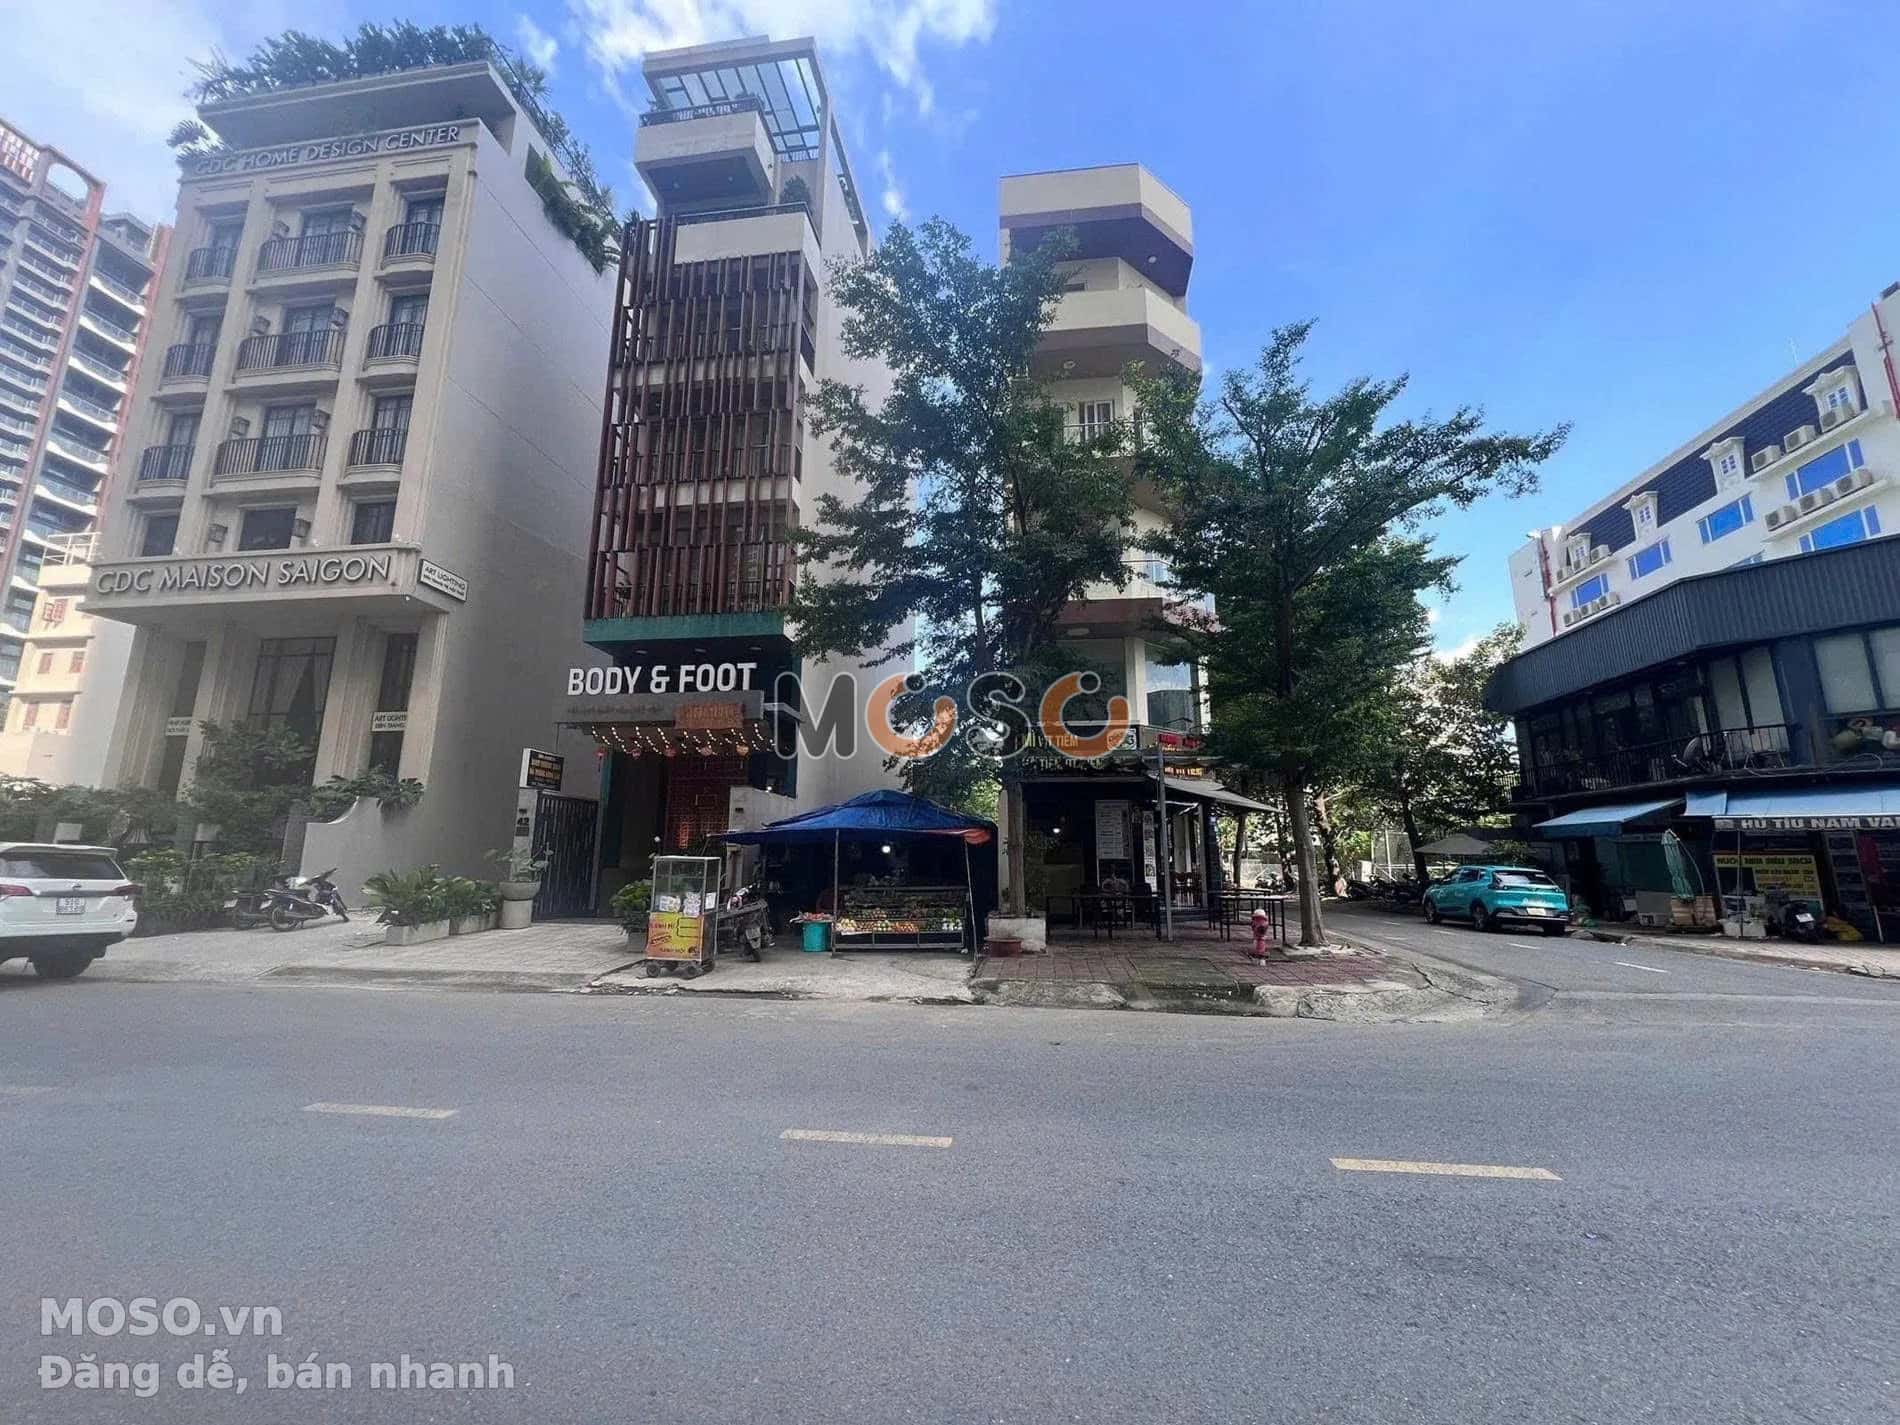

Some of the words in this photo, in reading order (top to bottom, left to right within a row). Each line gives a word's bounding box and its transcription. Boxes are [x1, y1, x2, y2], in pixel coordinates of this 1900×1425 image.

[241, 148, 299, 170] HOME
[303, 136, 378, 161] DESIGN
[384, 126, 460, 150] CENTER
[97, 568, 153, 594] CDC
[158, 561, 271, 590] MAISON
[277, 555, 392, 584] SAIGON
[567, 666, 642, 696] BODY
[650, 665, 670, 694] &
[679, 662, 757, 693] FOOT
[1810, 817, 1861, 829] NAM
